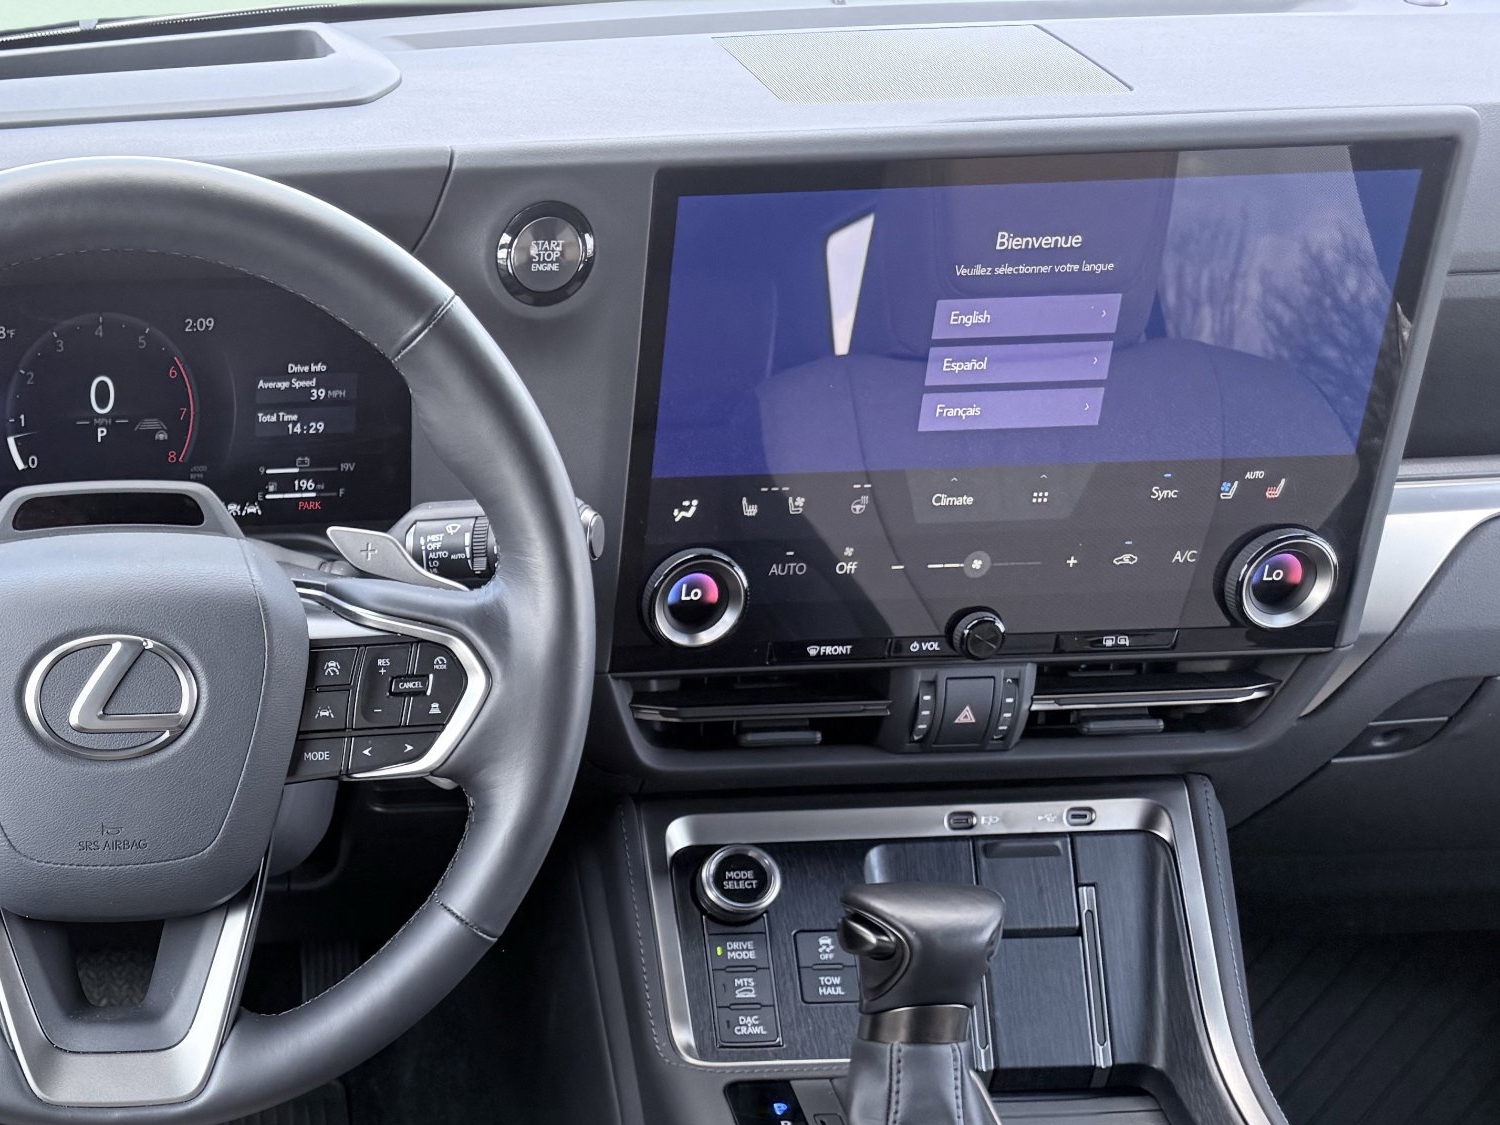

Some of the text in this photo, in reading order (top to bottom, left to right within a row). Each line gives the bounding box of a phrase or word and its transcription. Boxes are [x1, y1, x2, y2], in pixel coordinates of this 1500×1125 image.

[531, 240, 564, 251] START
[996, 231, 1082, 250] Bienvenue
[531, 250, 560, 261] STOP
[531, 263, 559, 271] ENGINE
[955, 260, 1114, 276] Veuillez sélectionner votre langue
[184, 317, 215, 332] 2:09
[950, 310, 991, 327] English
[95, 324, 103, 338] 4
[56, 339, 64, 353] 3
[138, 335, 146, 349] 5
[287, 361, 327, 374] Drive Info
[942, 357, 987, 373] Español
[26, 371, 35, 385] 2
[169, 365, 177, 380] 6
[257, 377, 316, 391] Average Speed
[90, 375, 115, 414] 0
[310, 388, 346, 401] 39 MPH
[180, 406, 187, 421] 7
[257, 411, 298, 423] Total Time
[935, 404, 980, 421] Français
[19, 413, 25, 427] 1
[97, 427, 107, 443] P
[288, 422, 325, 435] 14:29
[28, 455, 38, 469] 0
[167, 450, 178, 464] 8
[1245, 470, 1265, 480] AUTO
[294, 479, 316, 492] 196
[258, 491, 264, 501] E
[339, 487, 345, 498] F
[1150, 486, 1179, 501] Sync
[298, 500, 321, 511] PARK
[931, 493, 974, 508] Climate
[426, 533, 445, 542] MIST
[426, 542, 442, 551] OFF
[428, 550, 449, 560] AUTO
[1172, 550, 1198, 563] A/C
[428, 560, 439, 568] LO
[768, 562, 807, 576] AUTO
[835, 560, 858, 576] Off
[1263, 563, 1284, 581] Lo
[681, 583, 703, 602] Lo
[820, 644, 852, 656] FRONT
[921, 641, 940, 652] VOL
[377, 658, 391, 667] RES
[398, 681, 423, 690] CANCEL
[303, 751, 330, 761] MODE
[78, 839, 148, 851] SRS AIRBAG
[725, 870, 754, 880] MODE
[723, 880, 757, 890] SELECT
[726, 940, 754, 951] DRIVE
[727, 950, 756, 960] MODE
[819, 951, 835, 961] OFF
[734, 977, 755, 987] MTS
[818, 976, 841, 987] TOW
[818, 985, 845, 996] HAUL
[738, 1015, 759, 1026] DAC
[734, 1025, 767, 1036] CRAWL
[773, 1102, 788, 1116] P
